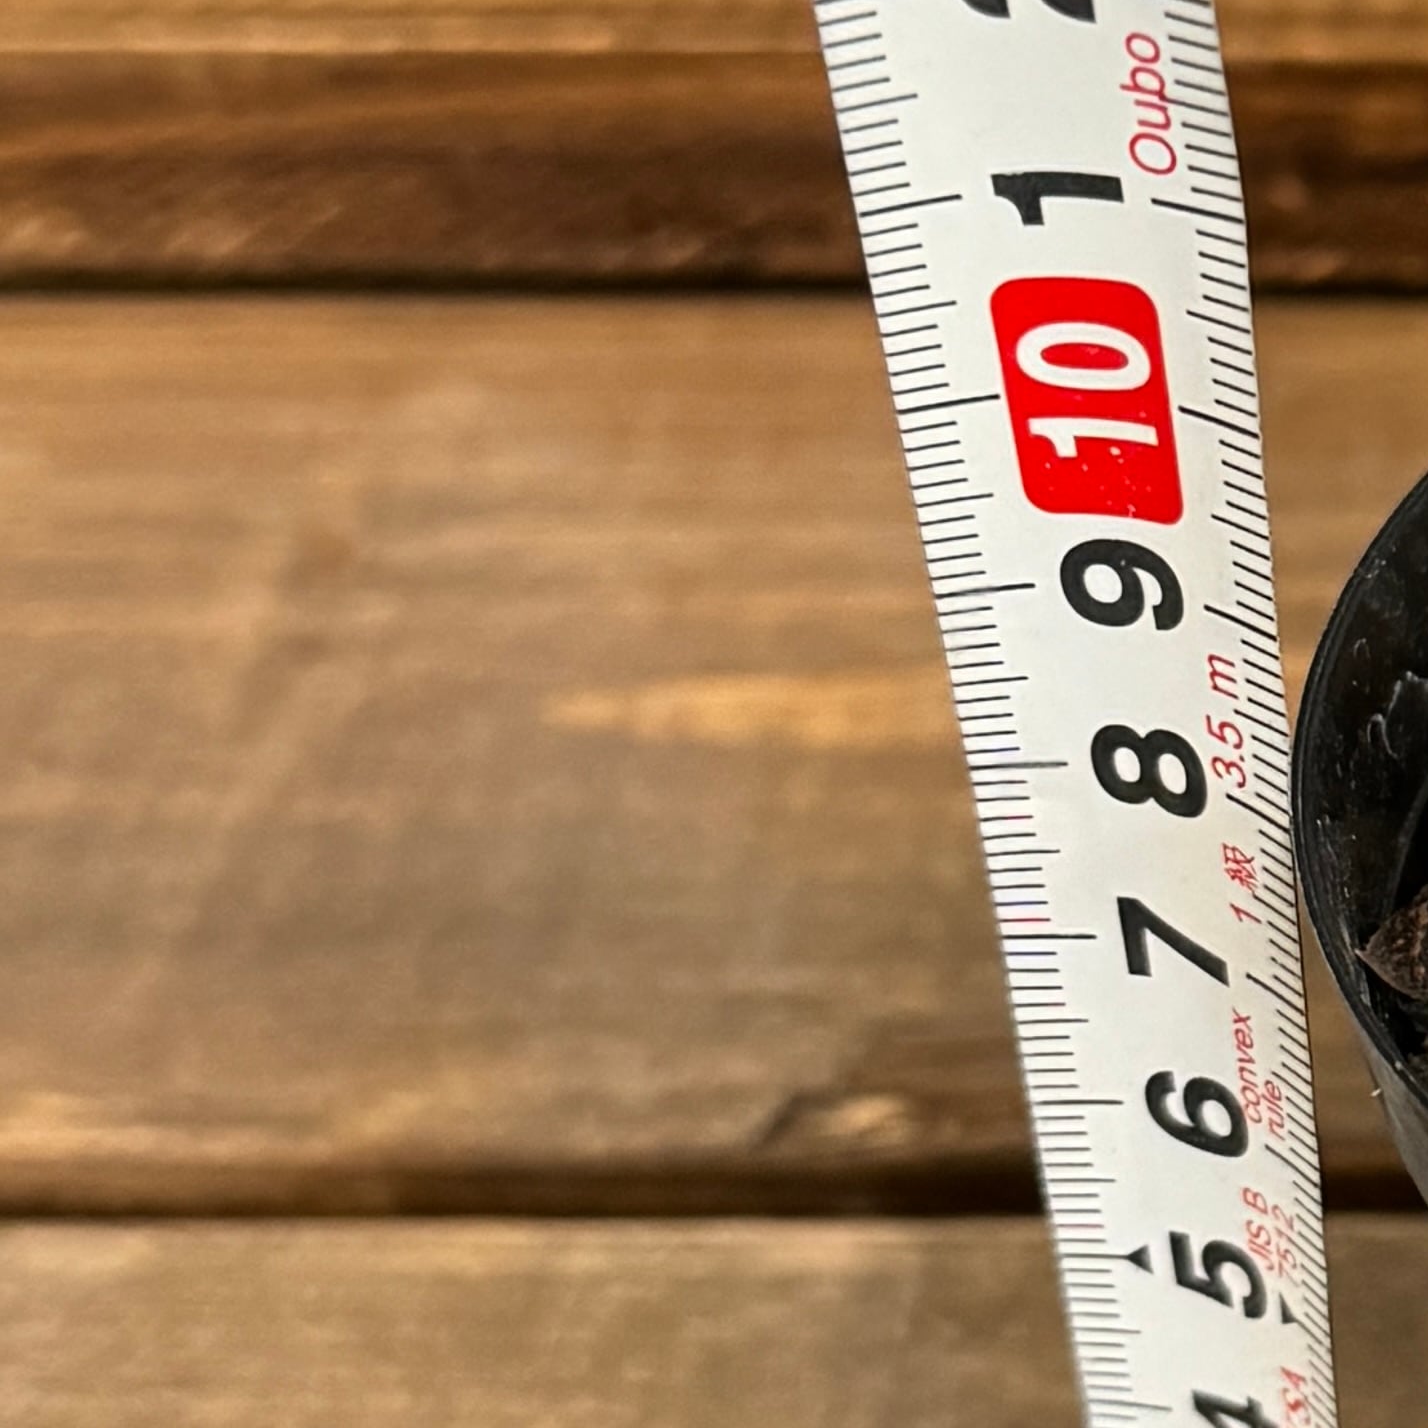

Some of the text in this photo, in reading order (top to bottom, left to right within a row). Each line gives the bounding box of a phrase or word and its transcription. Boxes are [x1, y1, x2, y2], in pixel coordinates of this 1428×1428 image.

[1120, 32, 1177, 176] Oubo
[992, 171, 1124, 226] 1
[1016, 321, 1159, 458] 10
[1060, 538, 1184, 632] 9
[1206, 653, 1247, 789] 3.5 m
[1090, 724, 1208, 819] 8
[1117, 896, 1230, 987] 7
[1232, 1006, 1263, 1124] convex
[1262, 1079, 1286, 1142] rule
[1145, 1071, 1249, 1159] 6
[1169, 1231, 1266, 1319] 5
[1242, 1186, 1275, 1272] JIS B
